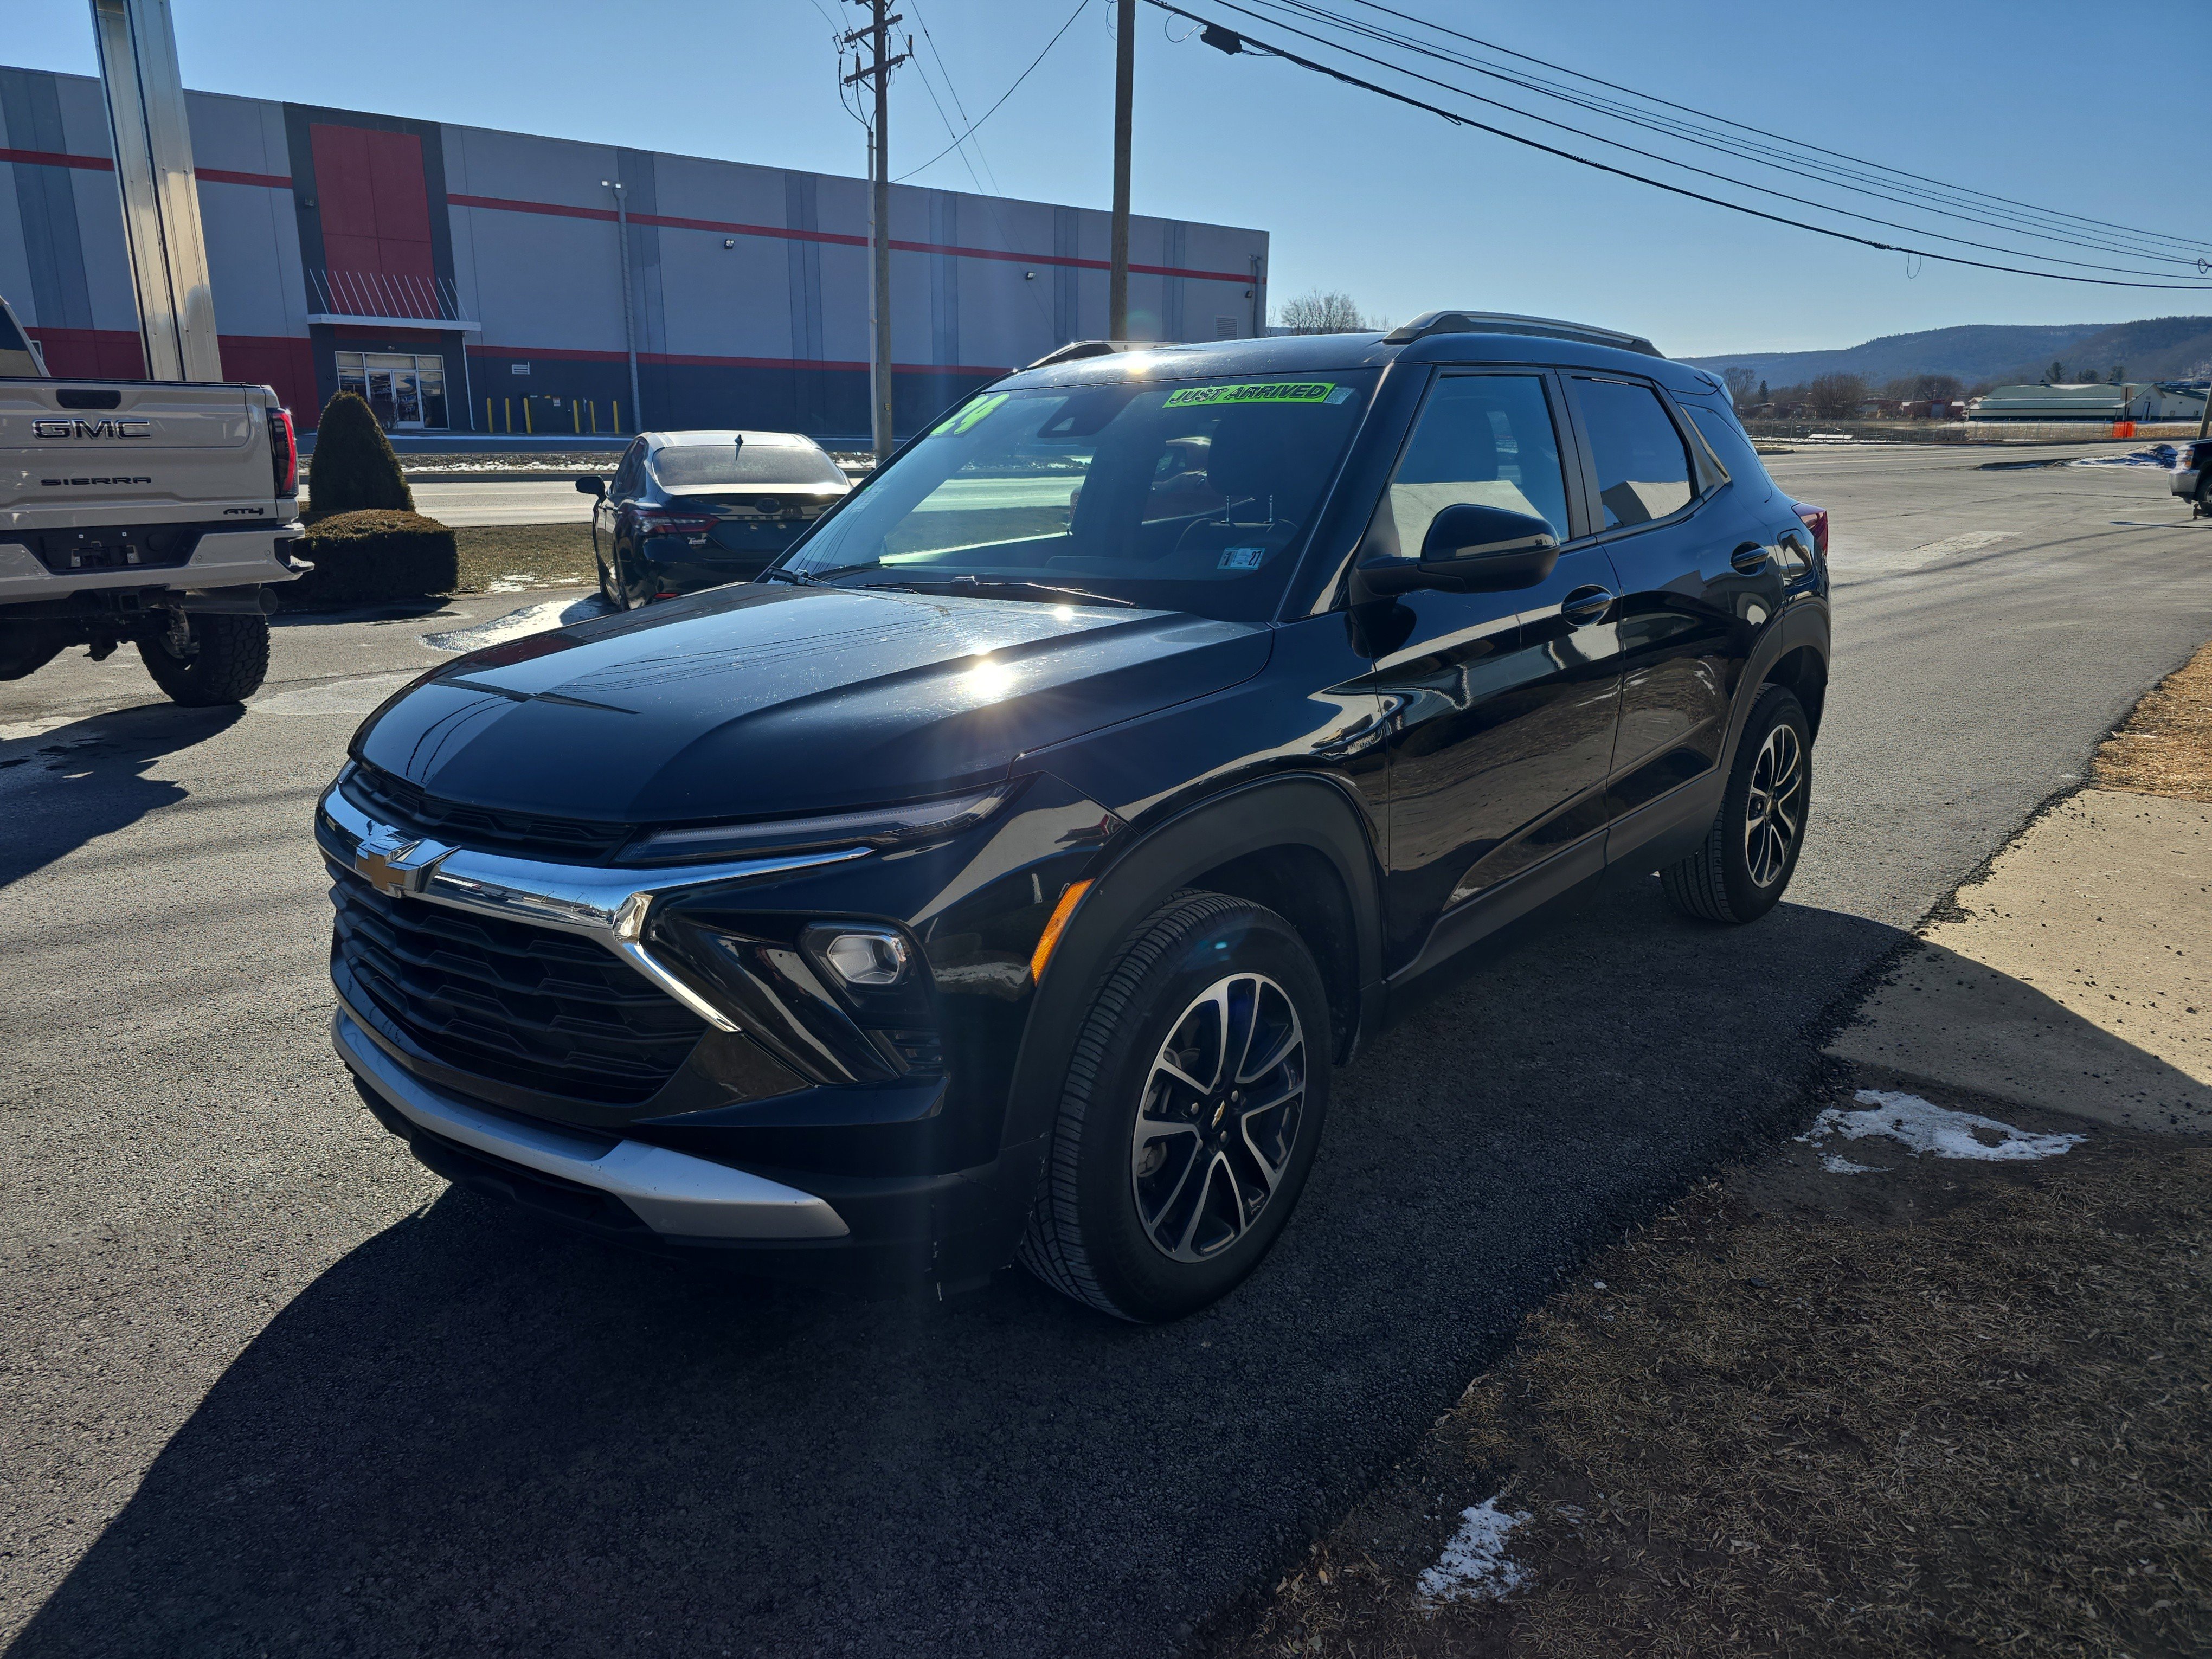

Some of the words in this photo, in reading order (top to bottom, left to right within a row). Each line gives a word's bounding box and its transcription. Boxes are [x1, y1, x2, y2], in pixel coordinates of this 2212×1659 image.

[1169, 388, 1228, 404] JUST
[1223, 384, 1328, 400] ARRIVED
[32, 419, 151, 439] GMC
[41, 477, 151, 486] SIERRA
[223, 507, 264, 516] AT4
[1248, 551, 1262, 567] 27
